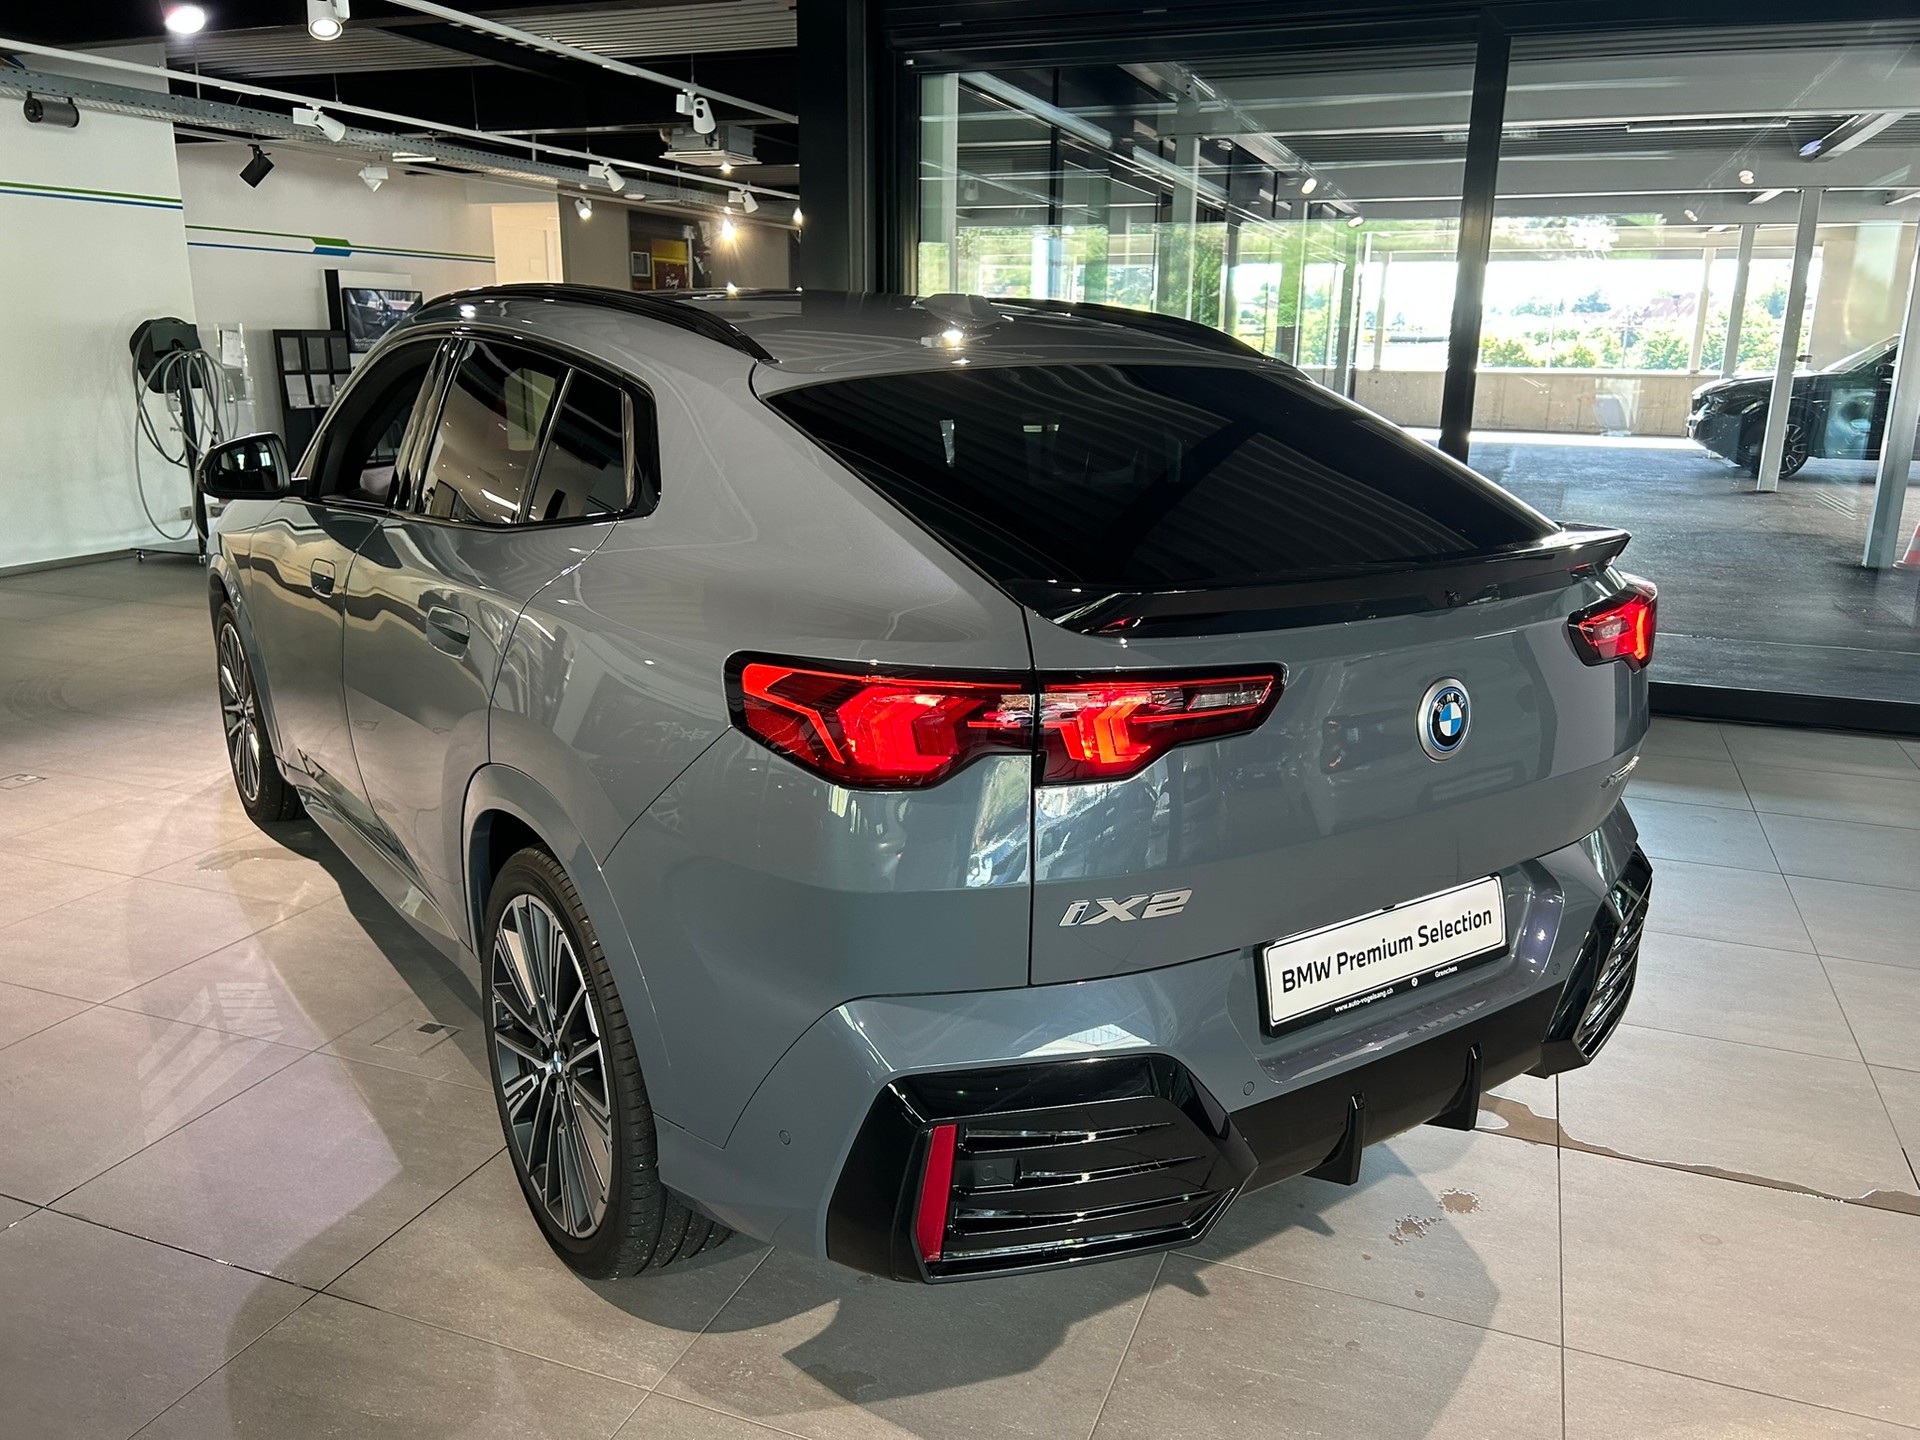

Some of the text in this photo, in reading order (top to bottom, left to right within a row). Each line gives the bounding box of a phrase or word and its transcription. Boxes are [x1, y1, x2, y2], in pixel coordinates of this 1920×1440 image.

[1434, 692, 1466, 713] BMW
[1282, 909, 1492, 993] BMW Premium Selection
[1334, 988, 1394, 1013] www.auto-vogelsang.ch
